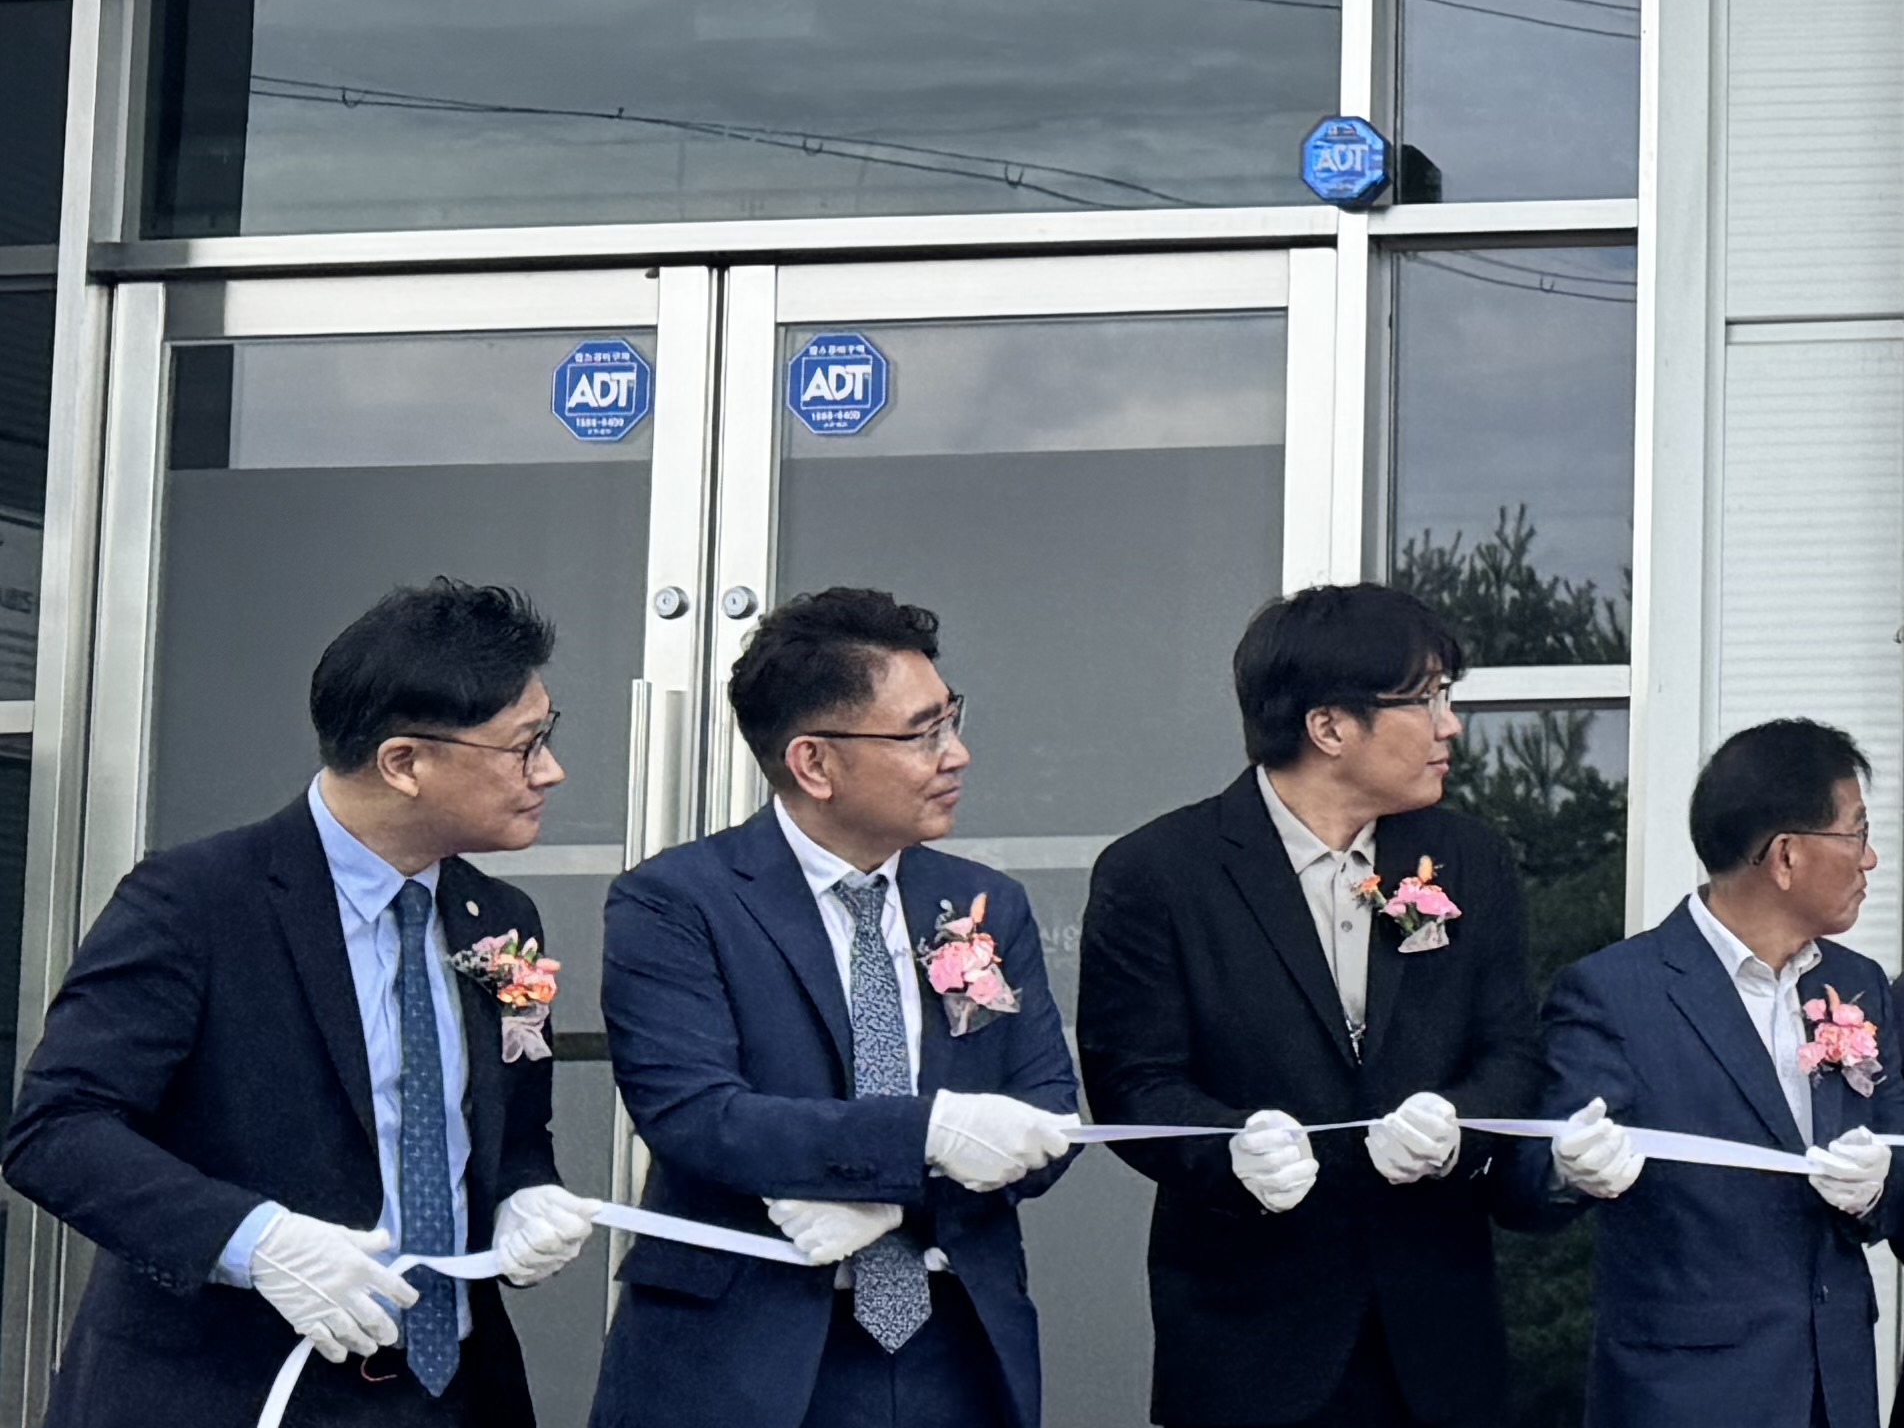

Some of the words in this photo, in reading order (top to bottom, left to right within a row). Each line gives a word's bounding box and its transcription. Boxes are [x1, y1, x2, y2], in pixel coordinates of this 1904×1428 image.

[1313, 144, 1369, 172] ADT
[567, 372, 636, 408] ADT
[801, 364, 872, 401] ADT
